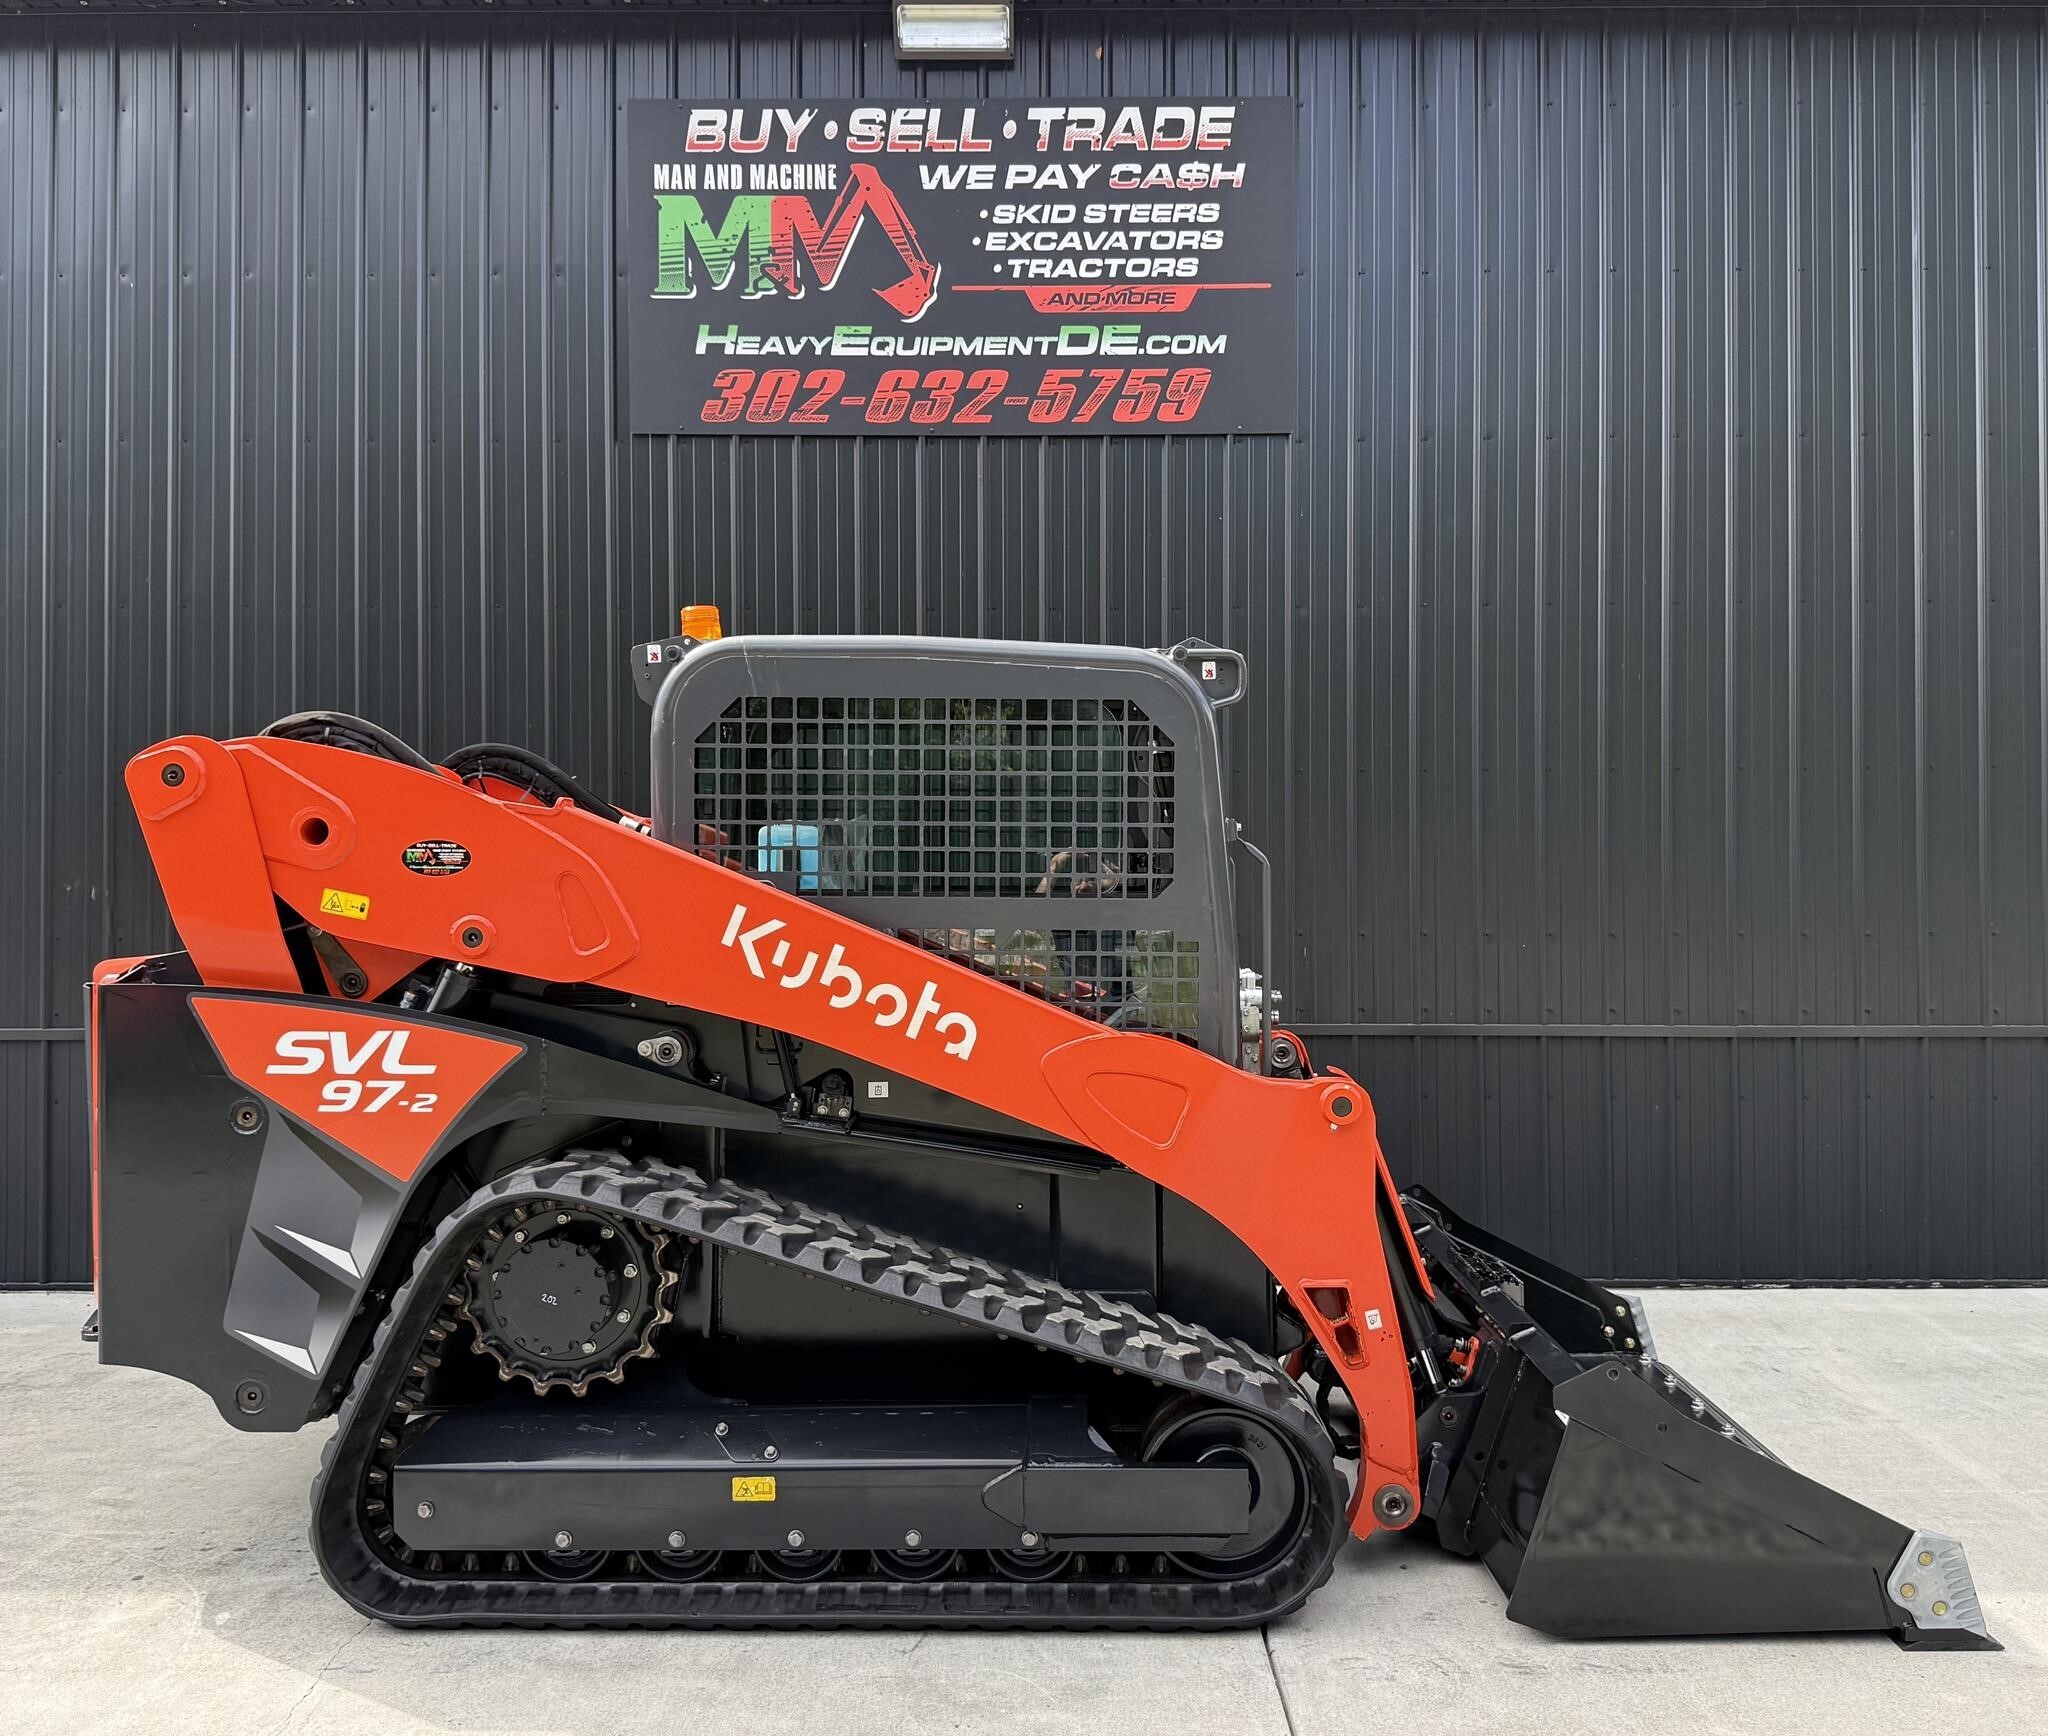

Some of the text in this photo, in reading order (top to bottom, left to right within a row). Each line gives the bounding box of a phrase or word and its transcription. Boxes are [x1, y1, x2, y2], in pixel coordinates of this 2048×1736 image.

[684, 105, 1236, 153] BUY SELL TRADE
[653, 163, 837, 191] MAN AND MACHINE
[918, 161, 1246, 191] WE PAY CA$H
[992, 202, 1221, 225] SKID STEERS
[985, 230, 1224, 252] EXCAVATORS
[1007, 257, 1200, 279] TRACTORS
[1047, 291, 1177, 306] AND MORE
[699, 367, 1213, 424] 302-632-5759
[721, 903, 978, 1061] Kubota
[265, 1030, 438, 1075] SVL
[317, 1079, 438, 1113] 97-2
